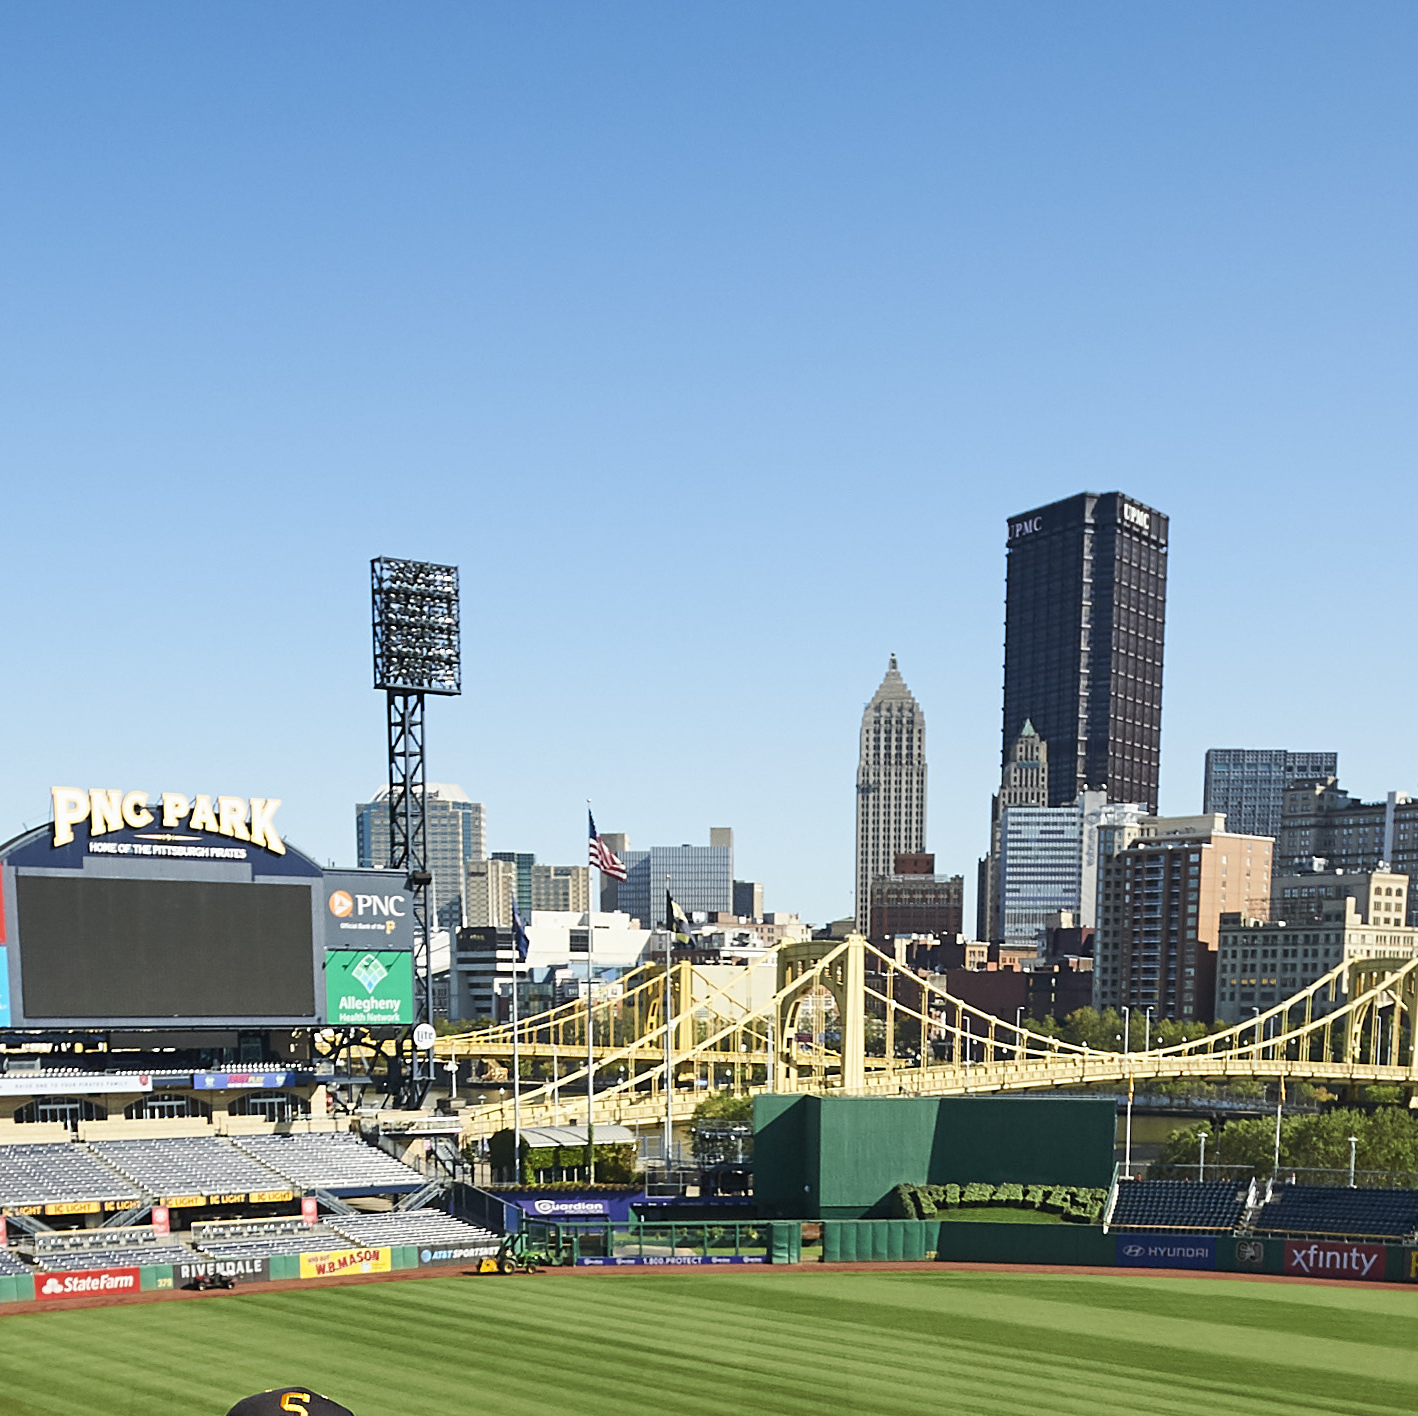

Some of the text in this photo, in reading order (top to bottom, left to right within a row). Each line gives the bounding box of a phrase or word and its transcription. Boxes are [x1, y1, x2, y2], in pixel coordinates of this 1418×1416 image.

[1123, 503, 1150, 530] UPMC
[1007, 516, 1043, 541] UPMC
[51, 786, 286, 856] PNC PARK
[89, 841, 247, 860] HOME OF THE PITTSBURGH PIRATES
[355, 894, 406, 917] PNC
[338, 996, 401, 1013] Allegheny
[339, 1012, 401, 1022] Health Network
[417, 1030, 434, 1043] Lite
[221, 1193, 245, 1204] LIGHT
[269, 1191, 291, 1201] LIGHT
[54, 1202, 91, 1214] IC LIGHT
[104, 1201, 113, 1211] IC
[535, 1200, 603, 1215] Guardian
[431, 1248, 452, 1260] AT&T
[1148, 1246, 1209, 1258] HYUNDAI
[1291, 1244, 1378, 1276] xfinity
[181, 1259, 263, 1279] RIVENDALE
